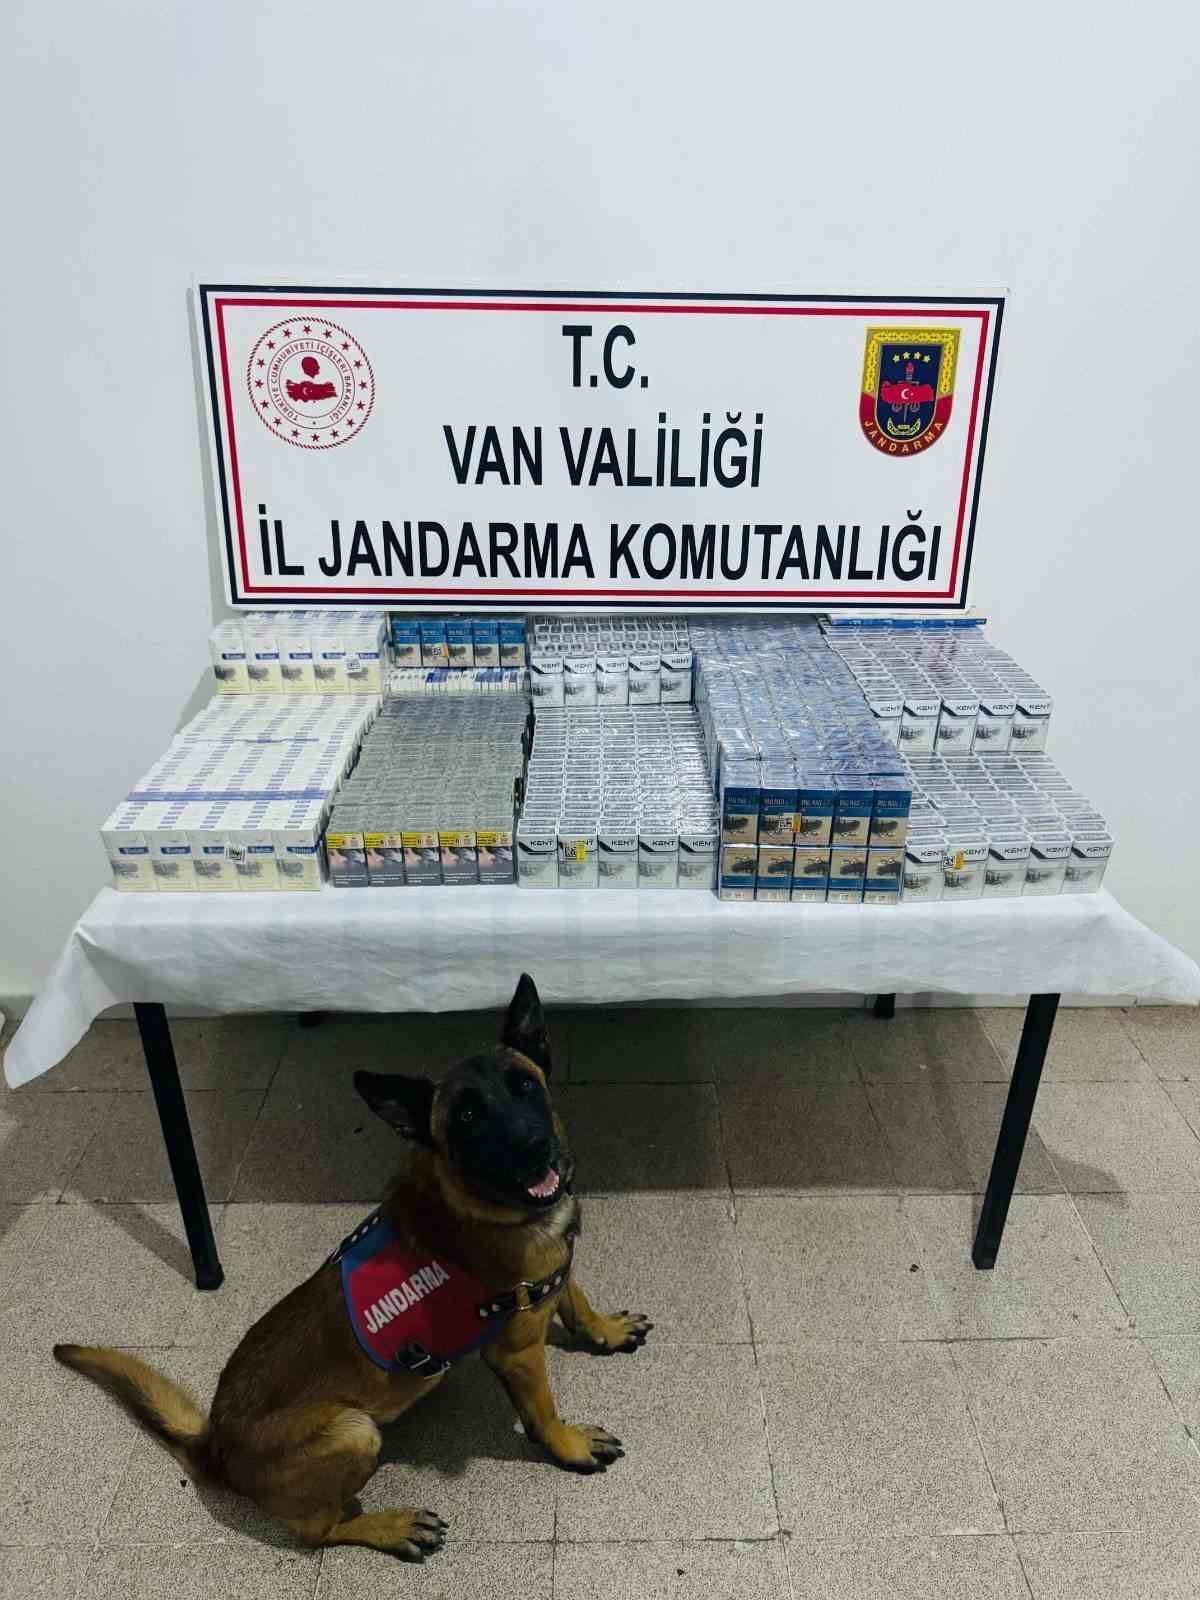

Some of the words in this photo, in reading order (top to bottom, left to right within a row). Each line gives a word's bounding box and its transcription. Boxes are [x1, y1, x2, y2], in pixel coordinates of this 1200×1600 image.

[563, 324, 649, 388] T.C.
[443, 425, 543, 486] VAN
[559, 411, 764, 489] VALİLİĞİ
[864, 420, 944, 453] JANDARMA
[258, 503, 304, 576] İL
[318, 519, 596, 580] JANDARMA
[609, 509, 942, 582] KOMUTANLIĞI
[364, 1260, 450, 1333] JANDARMA
